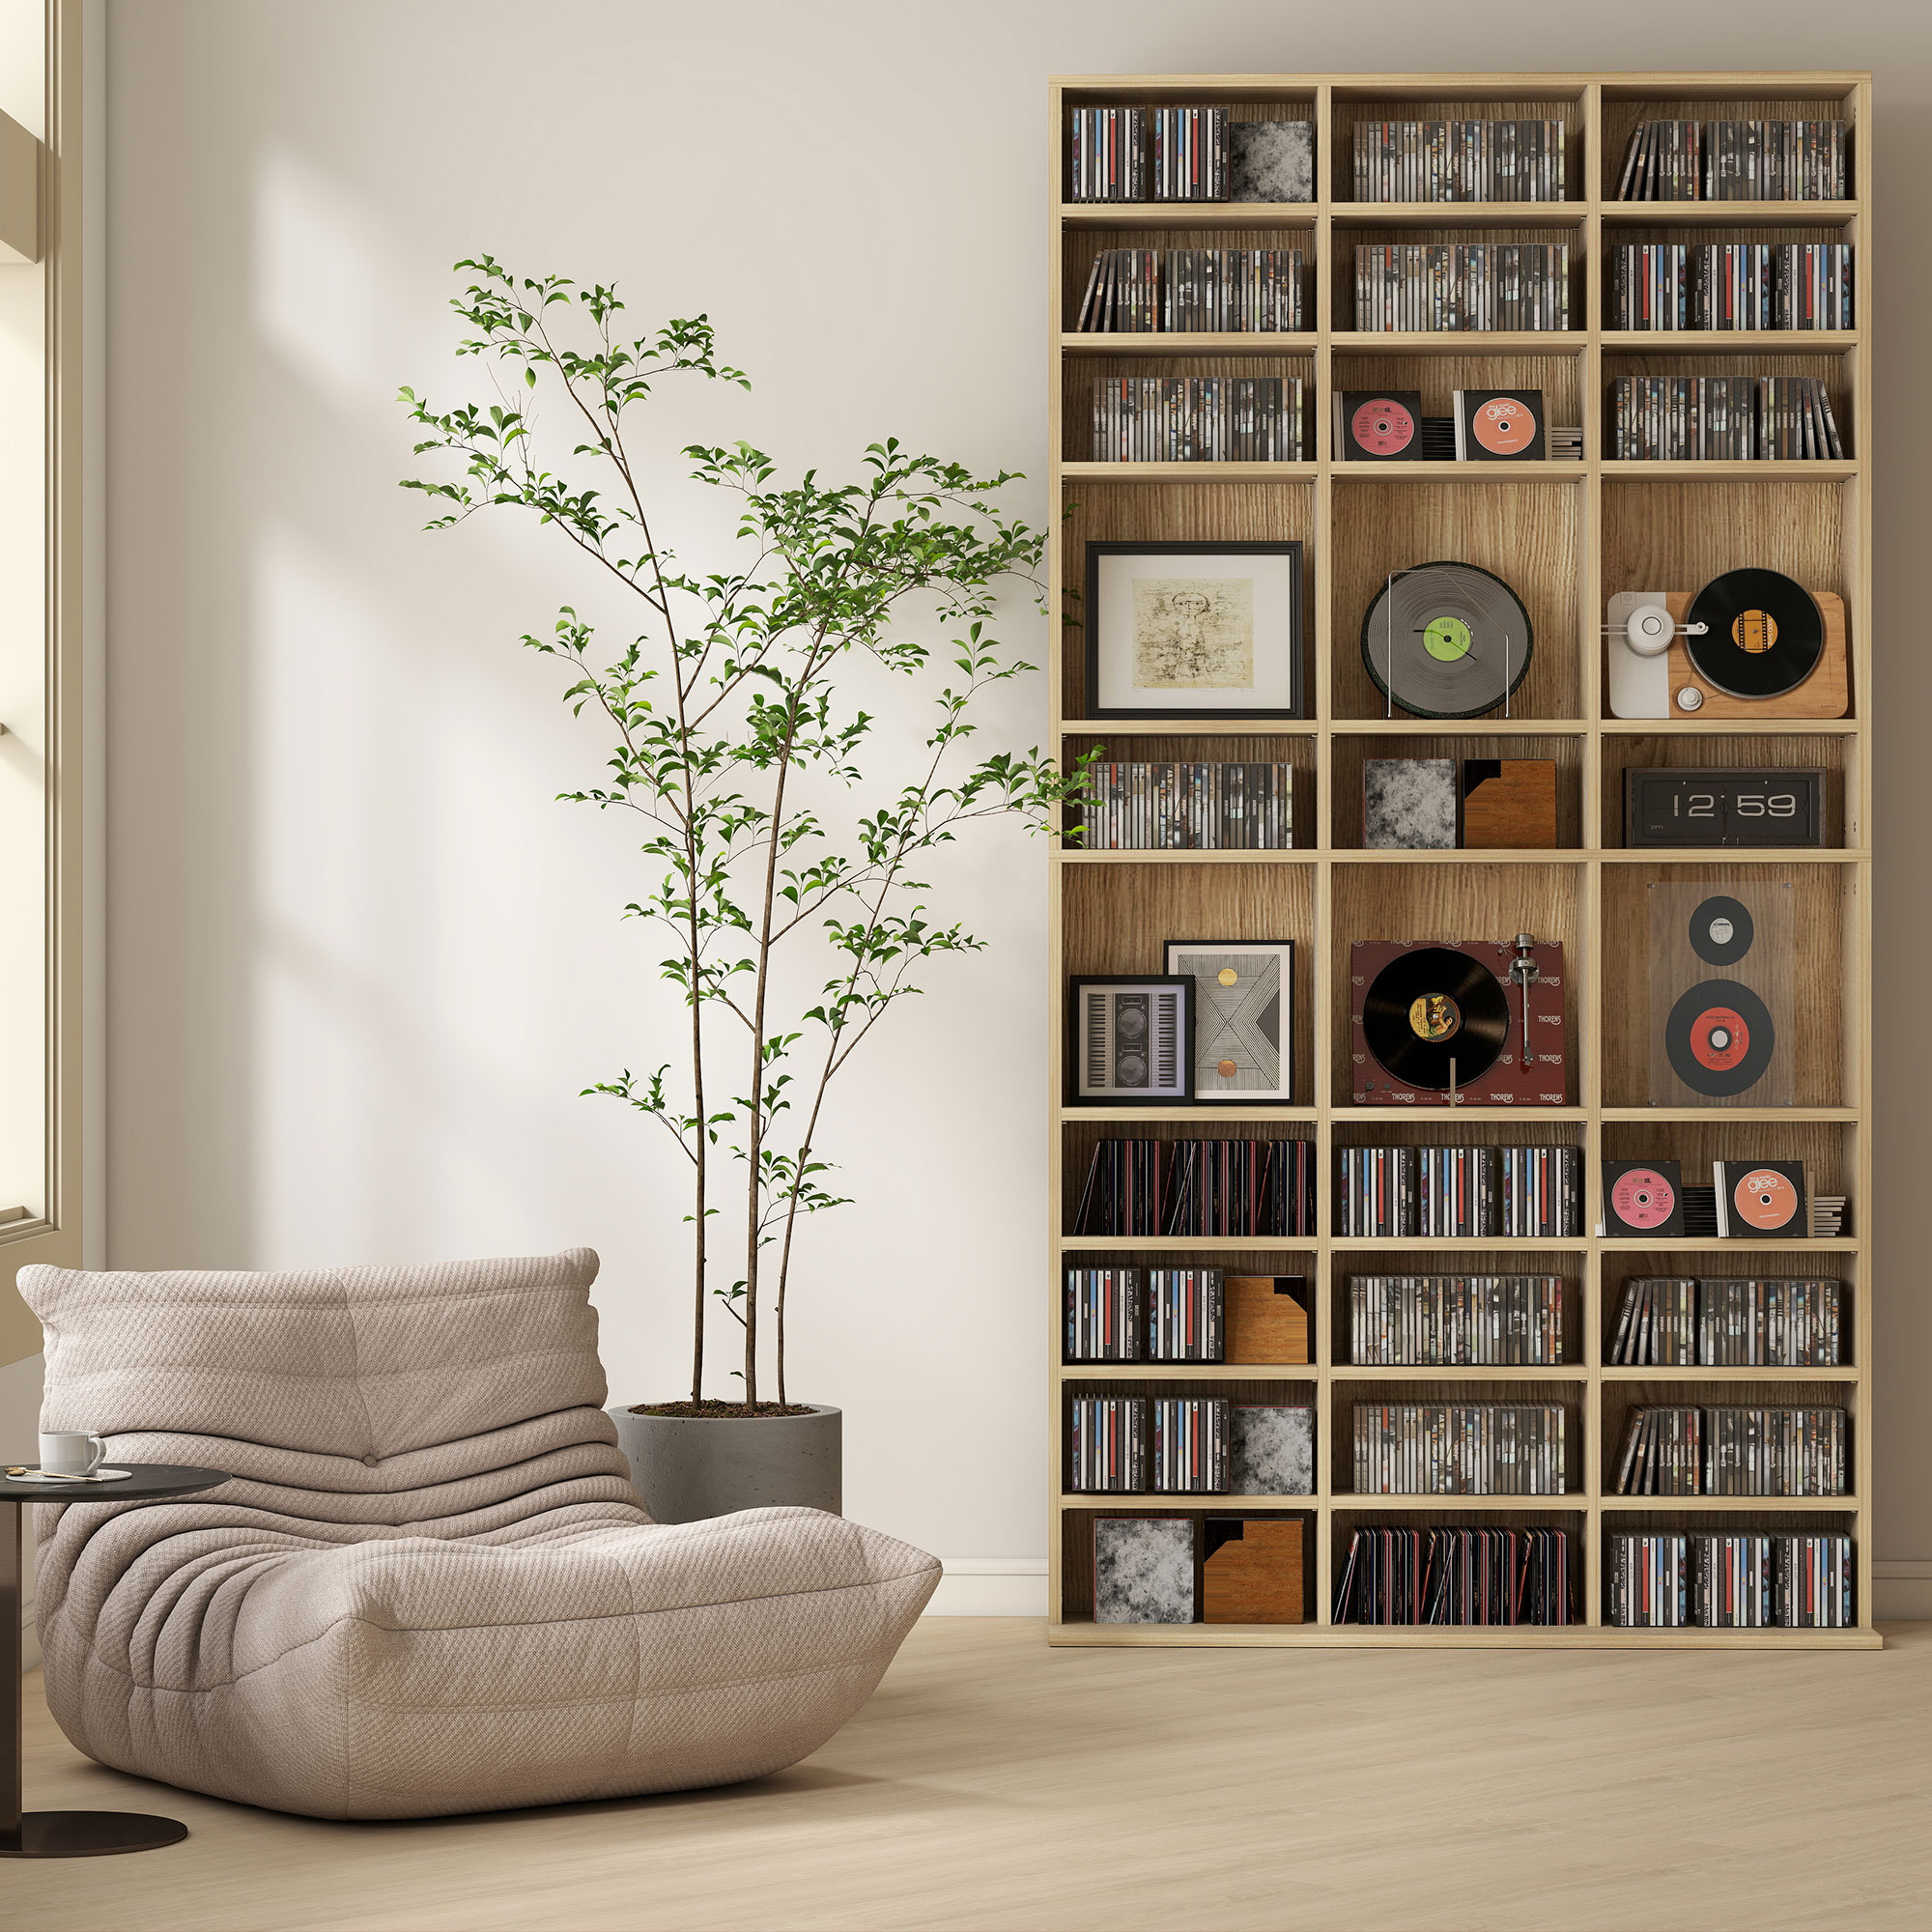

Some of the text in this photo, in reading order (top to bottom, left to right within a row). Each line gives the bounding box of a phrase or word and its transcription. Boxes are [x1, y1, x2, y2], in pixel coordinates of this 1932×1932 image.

[1487, 405, 1517, 421] glee
[1538, 1015, 1561, 1025] THORENS
[1538, 1054, 1562, 1065] THORENS
[1392, 1093, 1415, 1103] THORENS
[1490, 1093, 1514, 1104] THORENS
[1539, 1093, 1563, 1104] THORENS
[1747, 1177, 1778, 1194] glee
